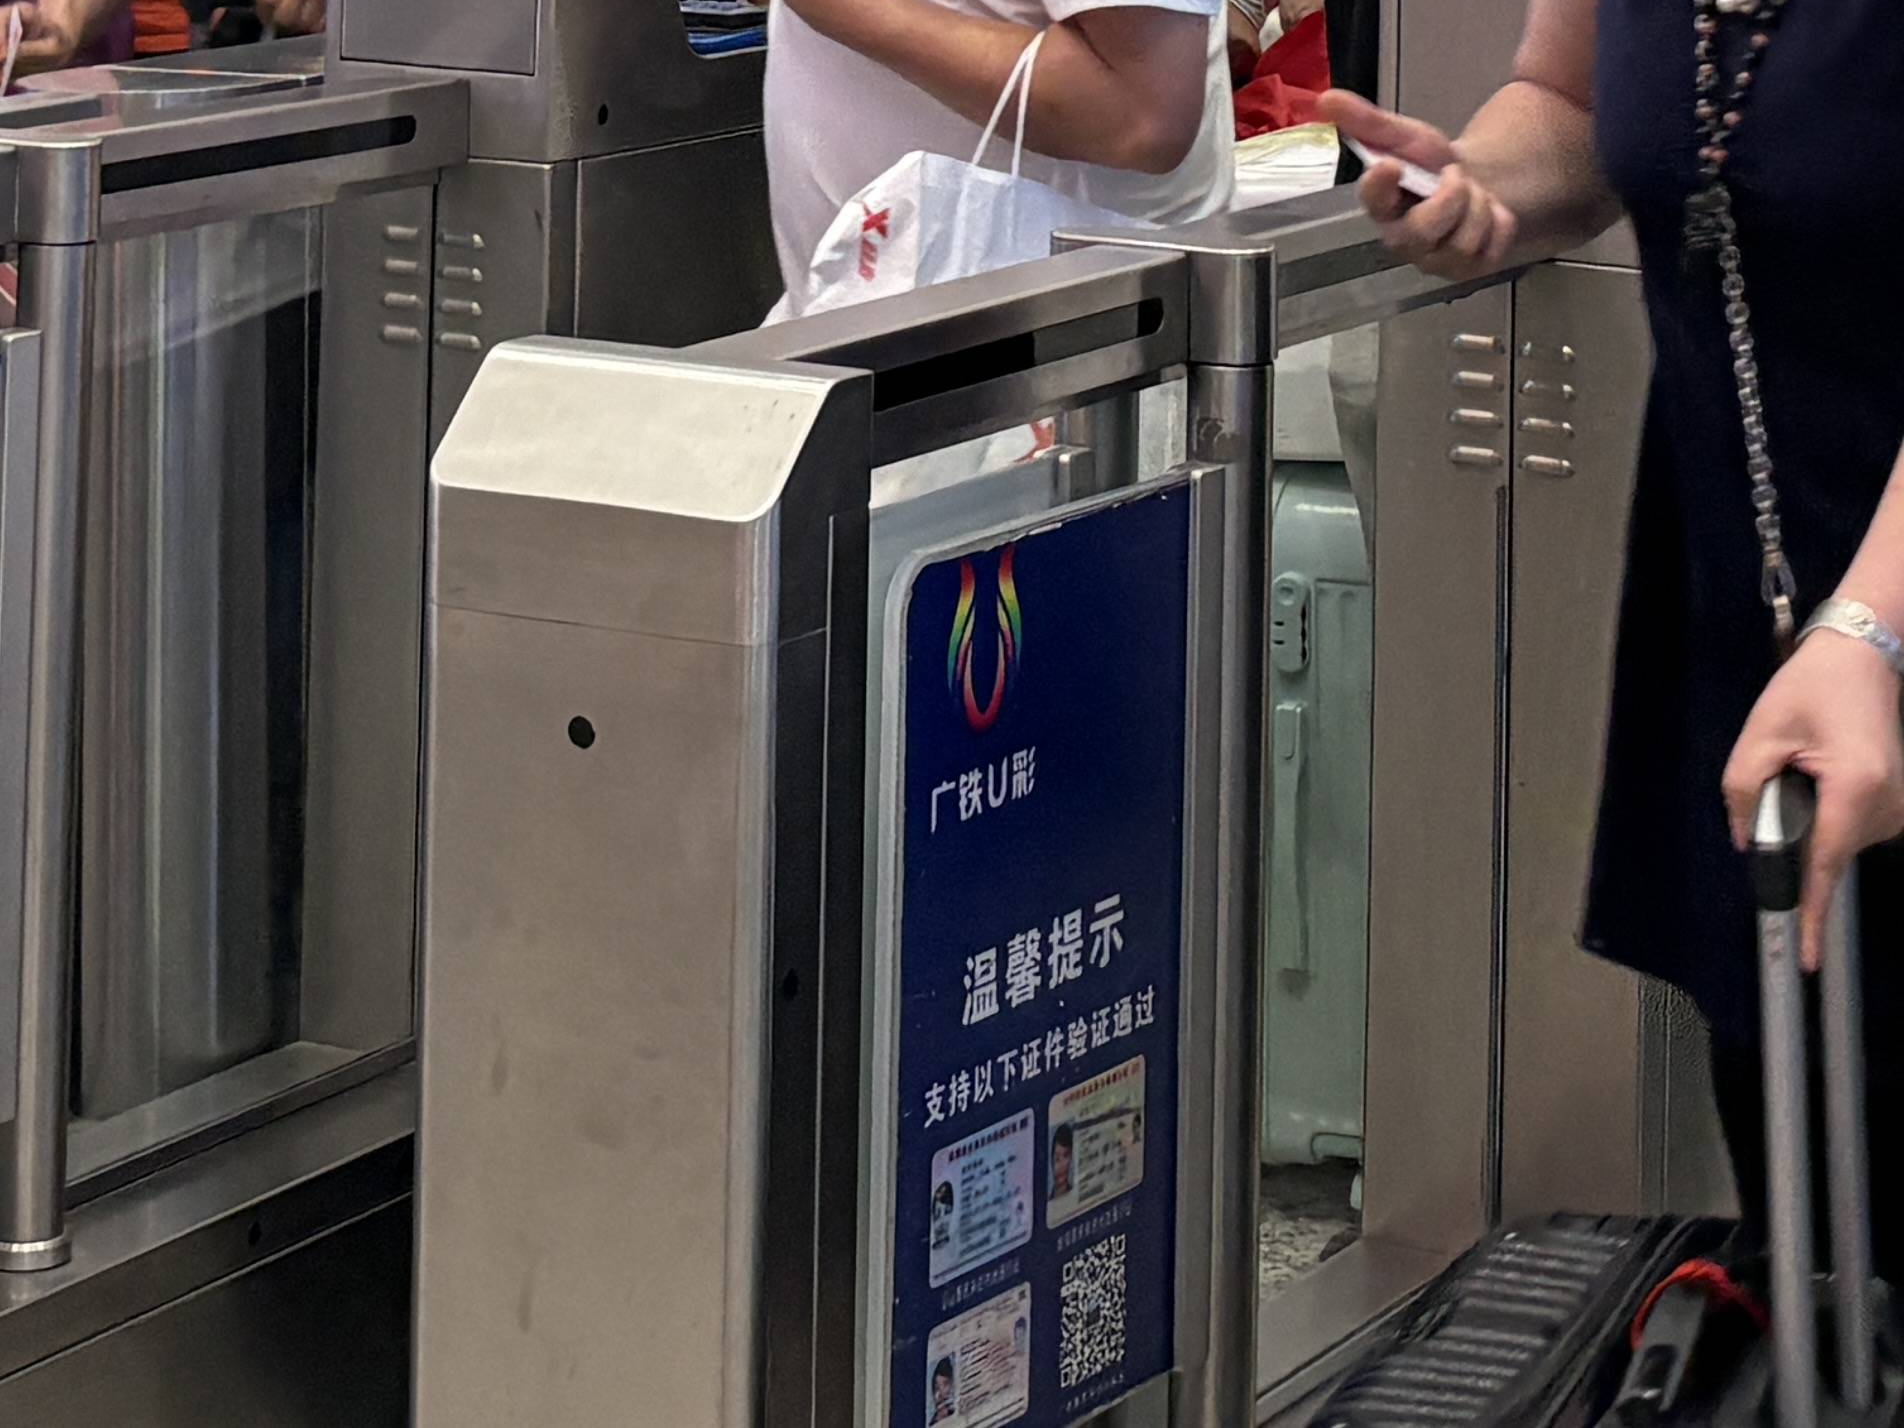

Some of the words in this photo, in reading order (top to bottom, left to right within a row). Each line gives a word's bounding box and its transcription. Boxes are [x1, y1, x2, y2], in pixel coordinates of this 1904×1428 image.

[930, 746, 1036, 834] 广铁U彩
[962, 894, 1124, 1026] 温馨提示
[924, 984, 1156, 1129] 支持以下证件验证通过
